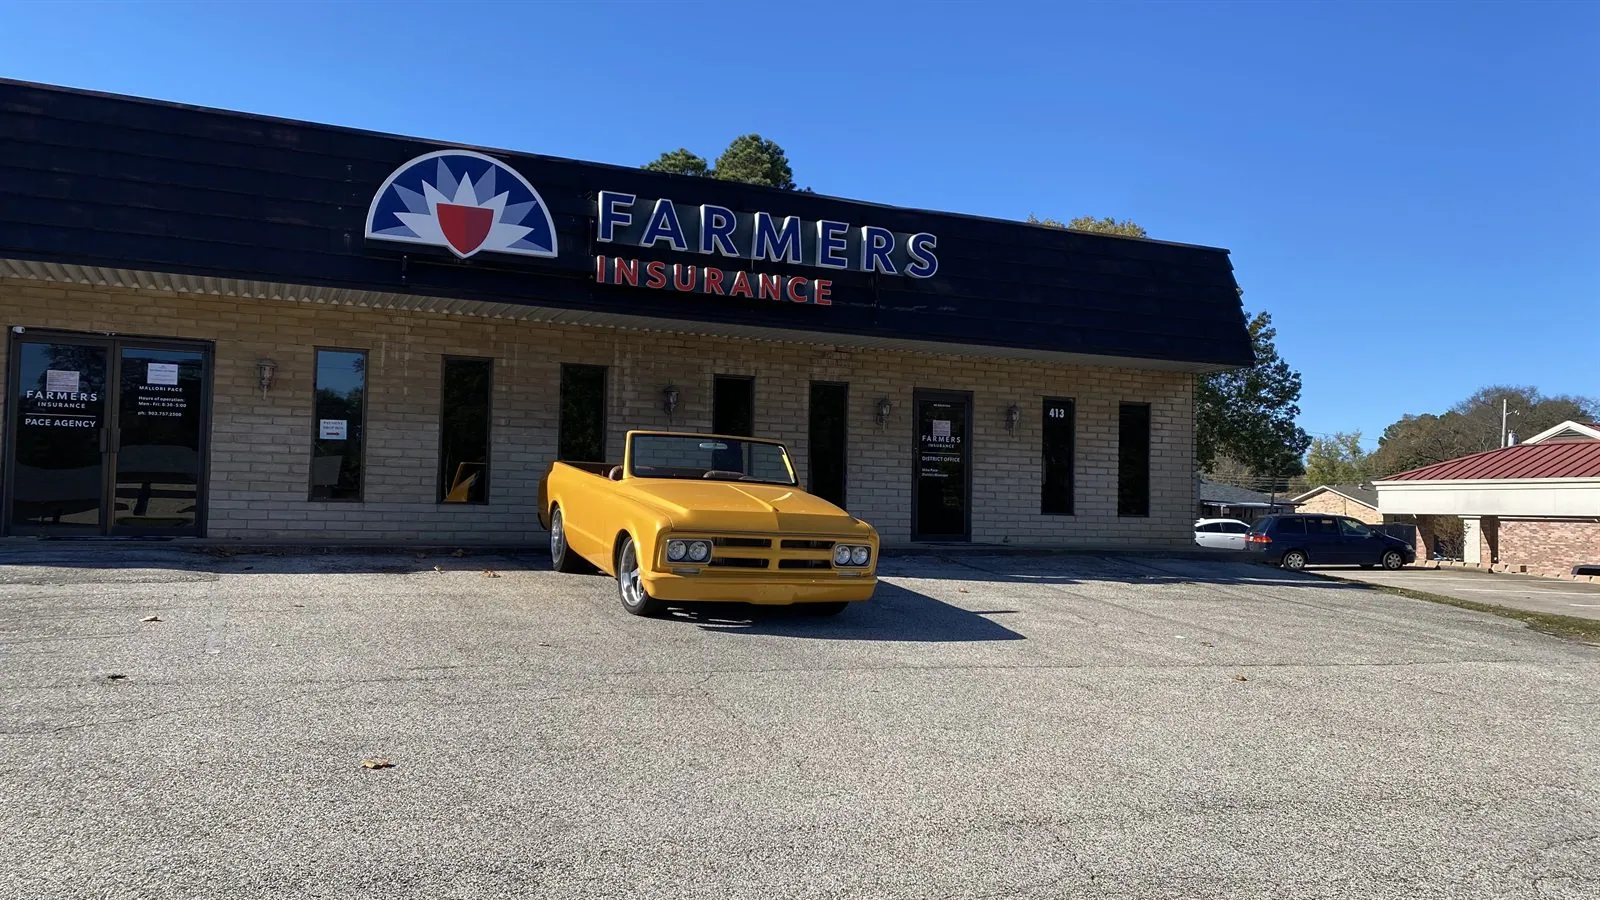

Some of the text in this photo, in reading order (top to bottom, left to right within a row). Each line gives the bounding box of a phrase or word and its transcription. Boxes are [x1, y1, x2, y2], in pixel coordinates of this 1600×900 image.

[597, 190, 939, 279] FARMERS
[596, 255, 833, 306] INSURANCE
[26, 390, 98, 402] FARMERS
[37, 401, 86, 409] INSURANCE
[1049, 408, 1065, 418] 413
[25, 418, 96, 428] PACE AGENCY
[921, 435, 961, 443] FARMERS
